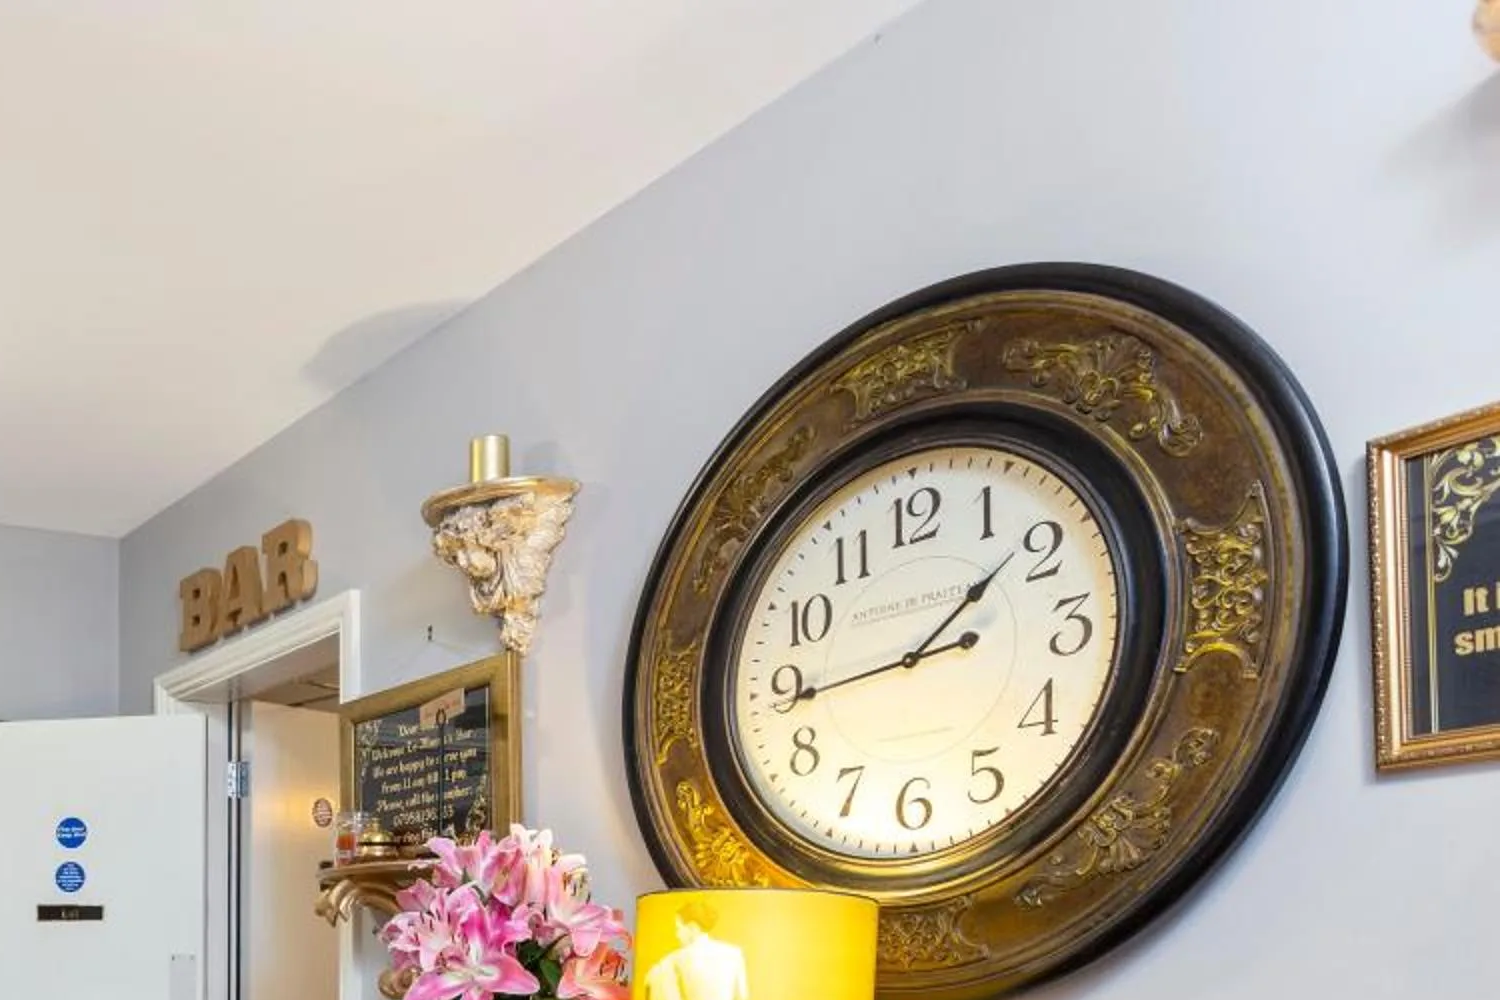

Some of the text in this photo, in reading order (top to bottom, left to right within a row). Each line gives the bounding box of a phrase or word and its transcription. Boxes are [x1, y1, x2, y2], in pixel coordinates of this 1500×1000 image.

[892, 486, 941, 549] 12
[979, 484, 996, 541] 1
[834, 528, 872, 586] 11
[1022, 520, 1065, 582] 2
[179, 517, 319, 653] BAR
[789, 592, 833, 649] 10
[1049, 590, 1096, 658] 3
[770, 664, 805, 714] 9
[1017, 678, 1060, 736] 4
[790, 724, 821, 776] 8
[966, 748, 1006, 805] 5
[837, 765, 866, 819] 7
[895, 776, 933, 832] 6
